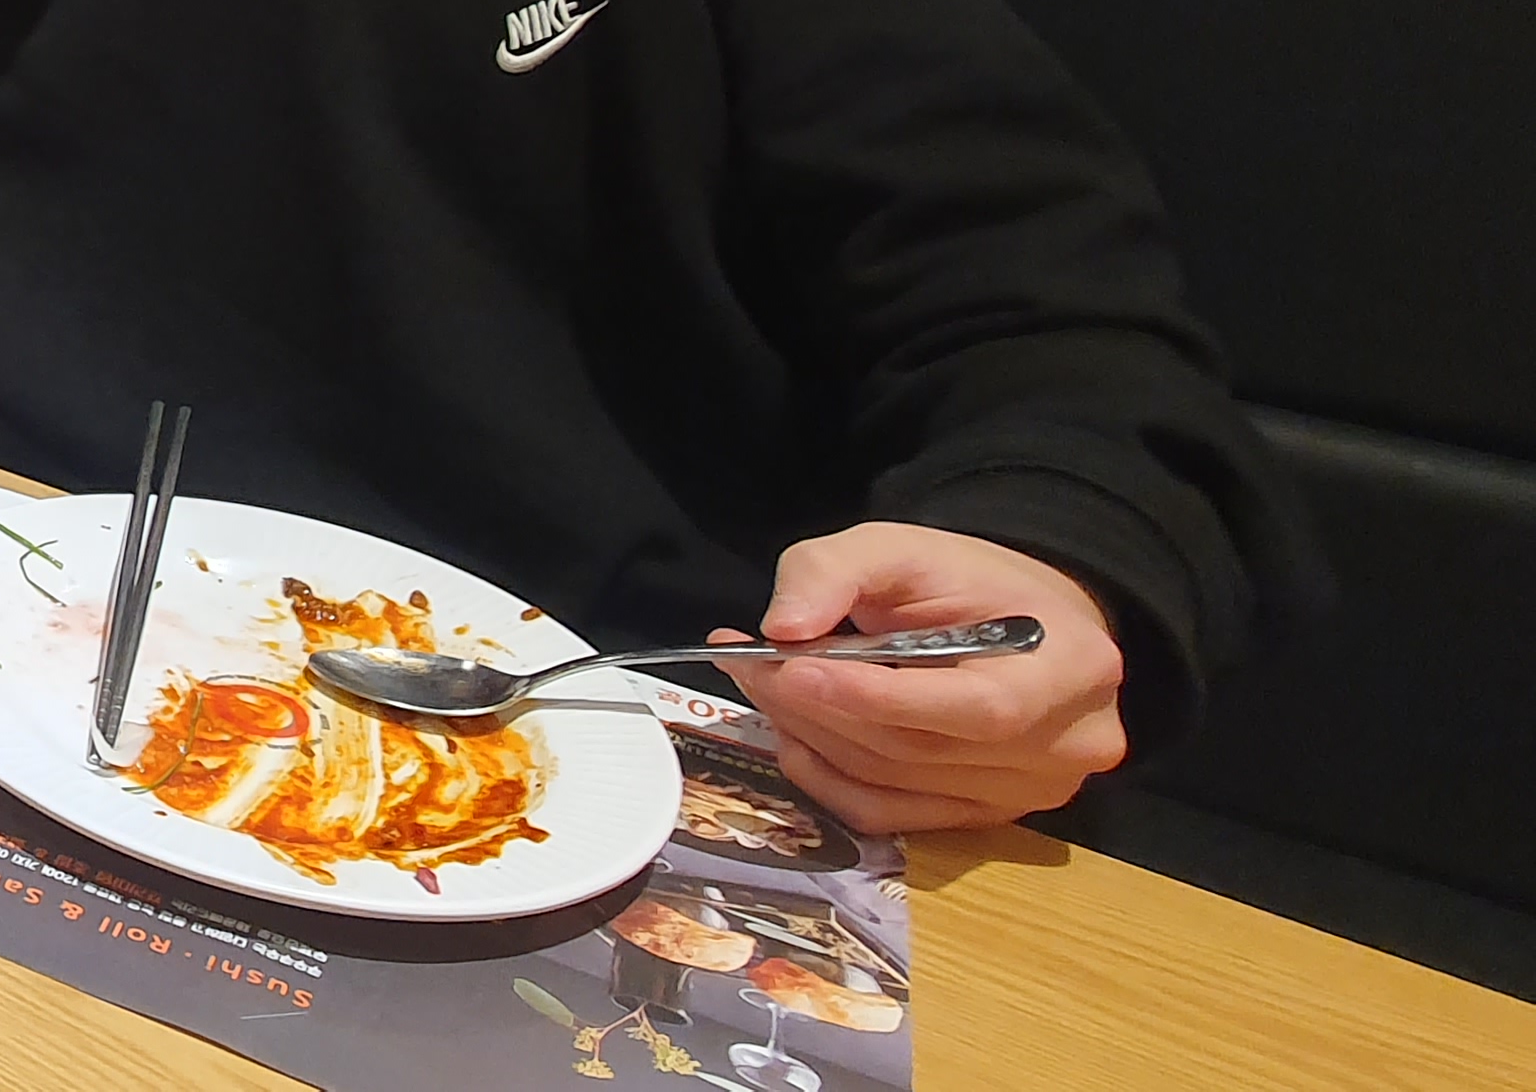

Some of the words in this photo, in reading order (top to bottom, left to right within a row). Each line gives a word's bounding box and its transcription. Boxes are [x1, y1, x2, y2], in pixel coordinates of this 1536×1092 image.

[61, 900, 86, 921] &
[99, 916, 172, 955] Roll
[207, 955, 314, 1009] Sushi
